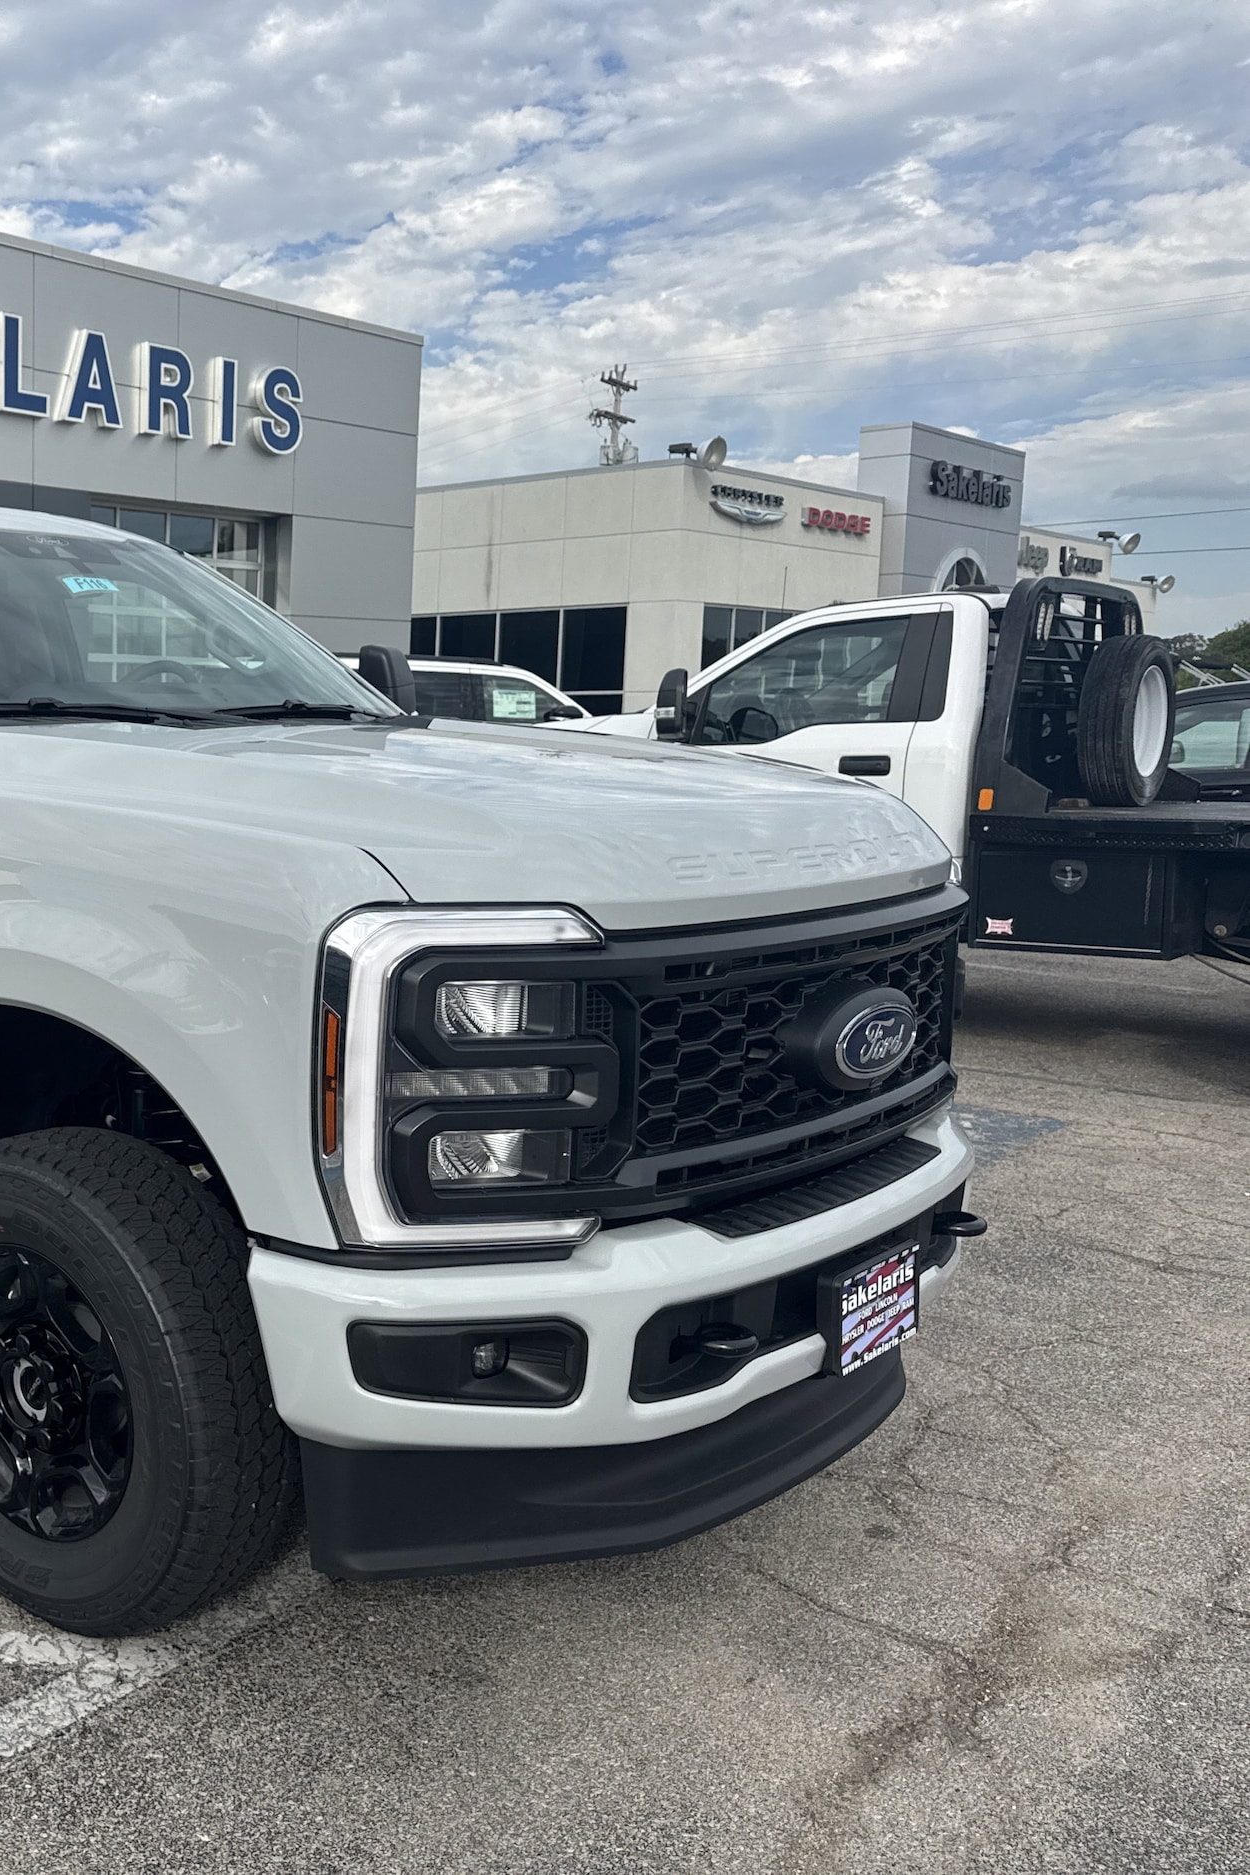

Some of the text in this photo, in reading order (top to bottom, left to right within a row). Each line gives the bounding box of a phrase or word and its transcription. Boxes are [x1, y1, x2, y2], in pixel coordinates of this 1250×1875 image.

[929, 459, 1013, 509] Sakelaris
[803, 507, 871, 535] DODGE
[1016, 536, 1050, 576] Jeep
[1075, 556, 1103, 574] RAM
[859, 1016, 906, 1065] Ford
[841, 1297, 915, 1346] HRYSLER DODGE JEEP RAM
[858, 1292, 899, 1321] FORD LINCOLN
[842, 1326, 918, 1377] www.Sakelaris.com
